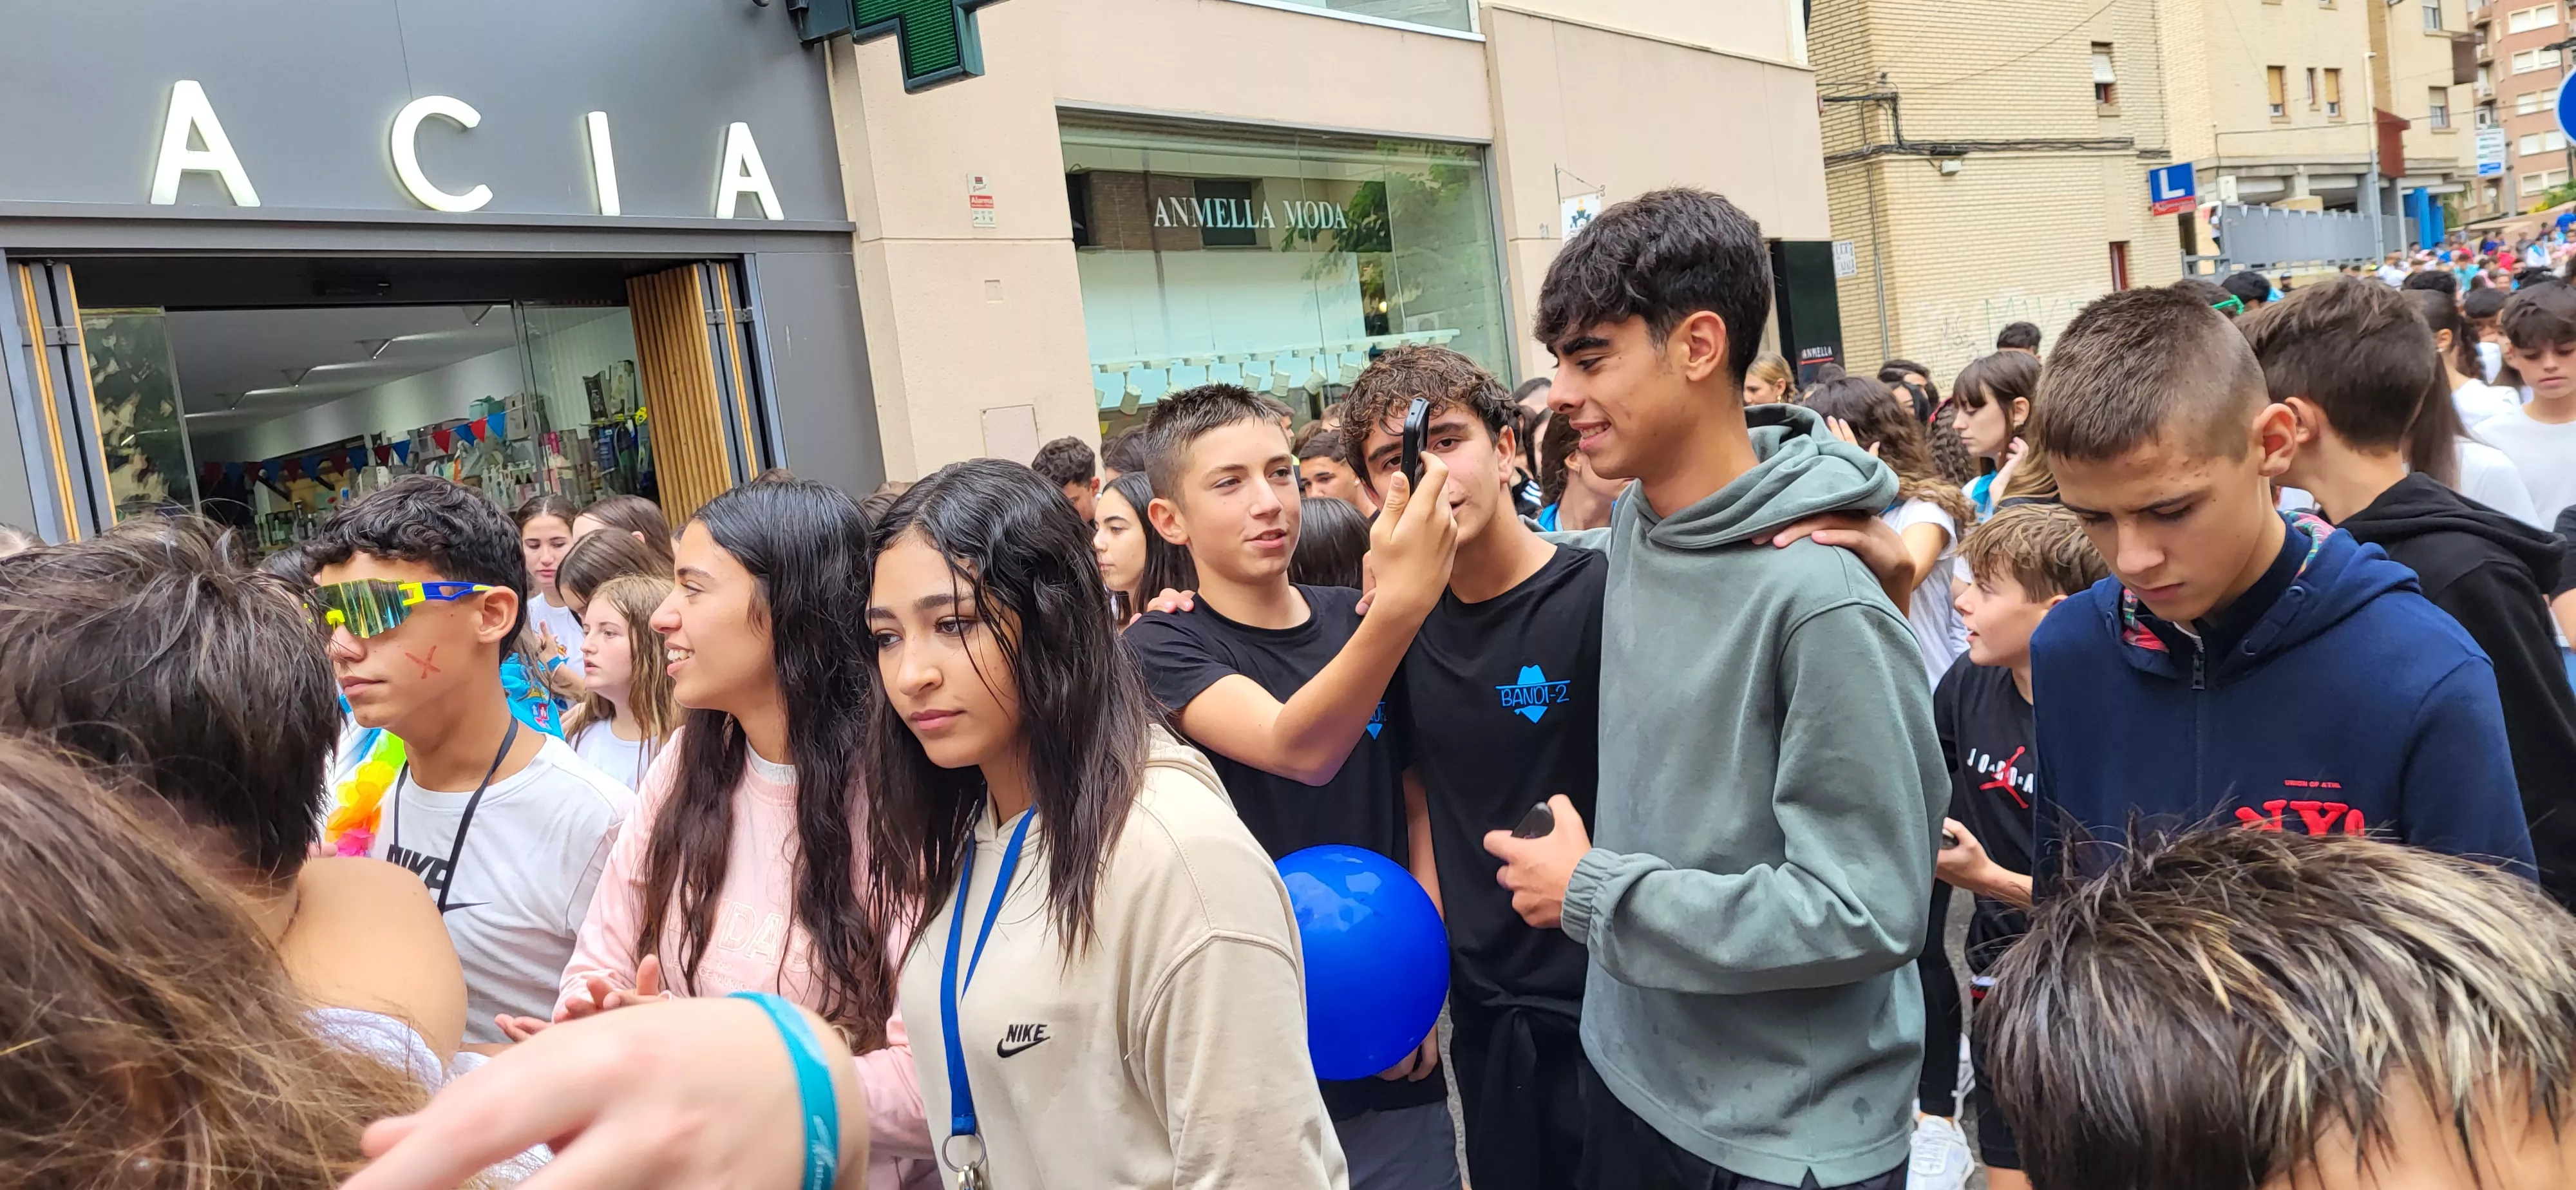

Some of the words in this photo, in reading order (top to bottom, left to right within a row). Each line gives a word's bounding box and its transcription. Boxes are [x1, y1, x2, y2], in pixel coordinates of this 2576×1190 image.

[2160, 169, 2186, 200] L
[1154, 196, 1276, 228] ANMELLA
[1282, 200, 1348, 229] MODA
[1802, 346, 1833, 359] ANMELLA
[1501, 684, 1570, 707] BANDI-2
[1966, 748, 2034, 794] JORDA
[1006, 1023, 1048, 1043] NIKE
